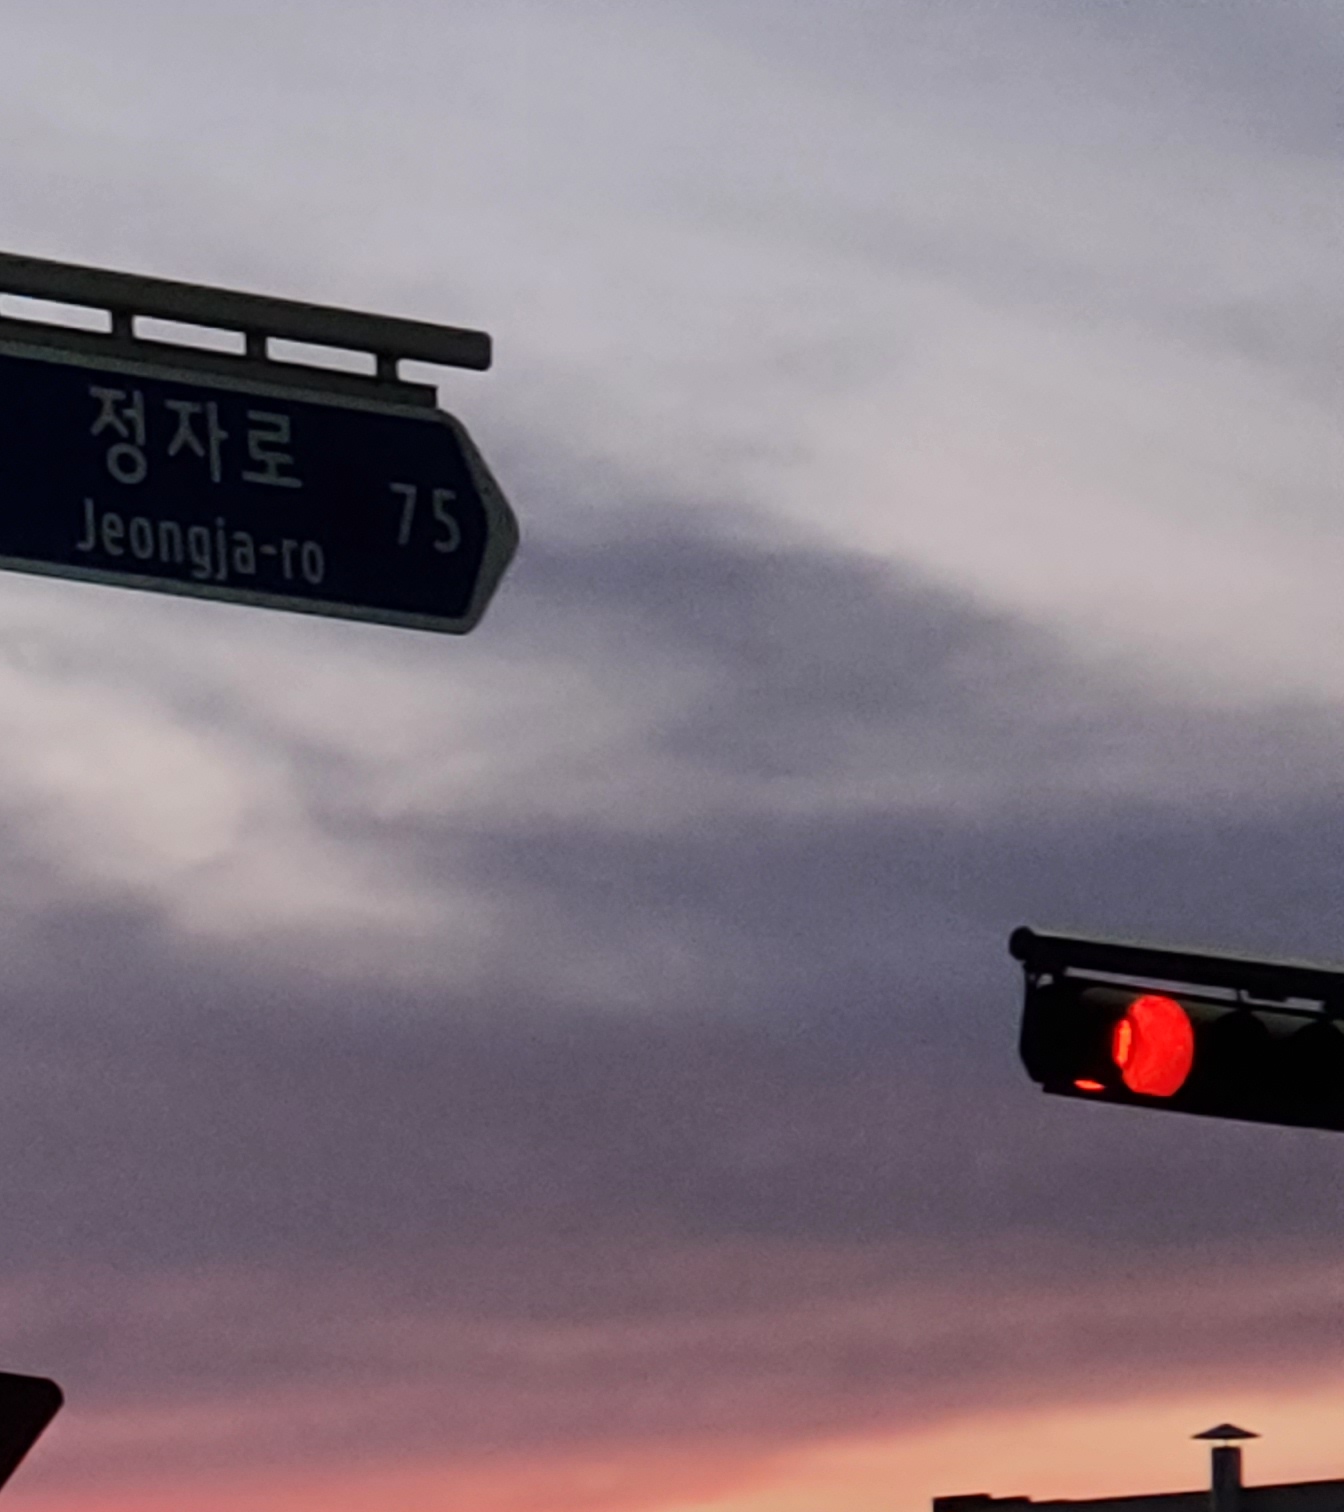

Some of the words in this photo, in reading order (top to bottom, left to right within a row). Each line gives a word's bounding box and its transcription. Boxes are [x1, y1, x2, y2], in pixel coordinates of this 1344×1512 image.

[88, 384, 304, 490] 정자로
[75, 497, 325, 585] Jeongja-ro
[388, 481, 462, 554] 75
